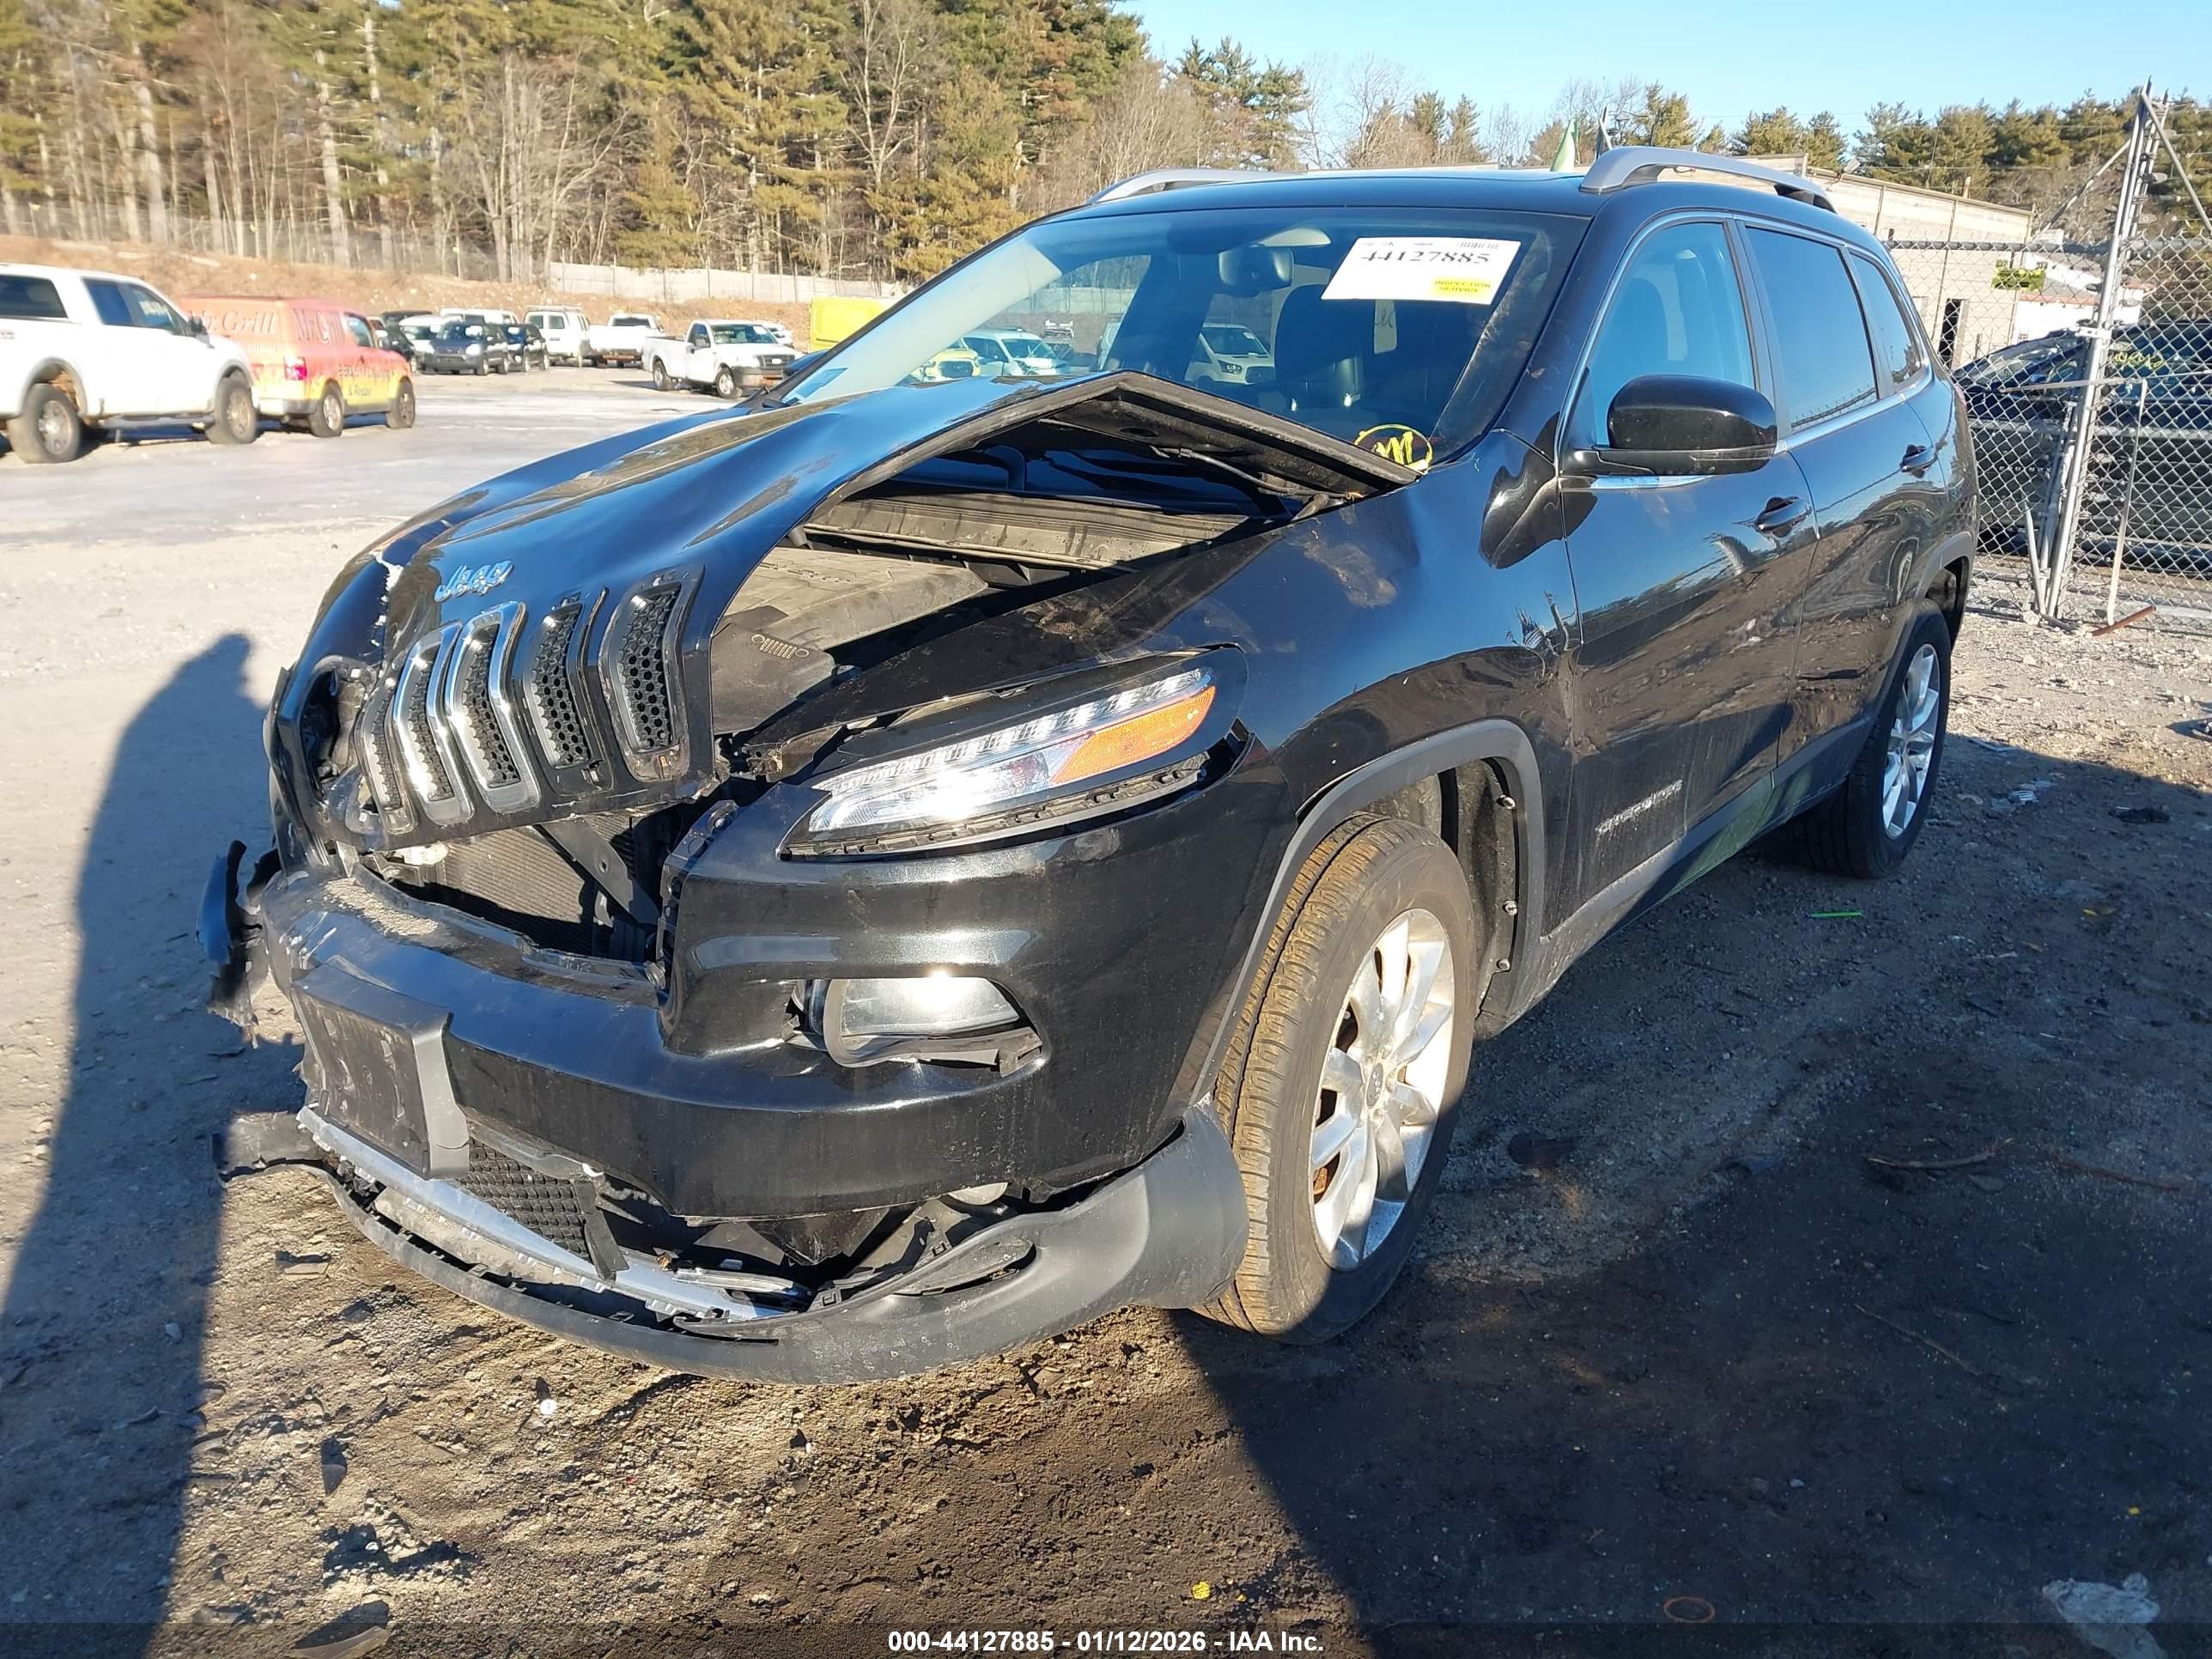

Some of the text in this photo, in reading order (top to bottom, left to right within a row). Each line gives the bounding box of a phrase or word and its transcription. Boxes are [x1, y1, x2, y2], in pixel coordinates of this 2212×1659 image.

[1361, 250, 1491, 264] 44127885
[1434, 279, 1492, 289] INSPECTION
[434, 559, 515, 603] Jeep
